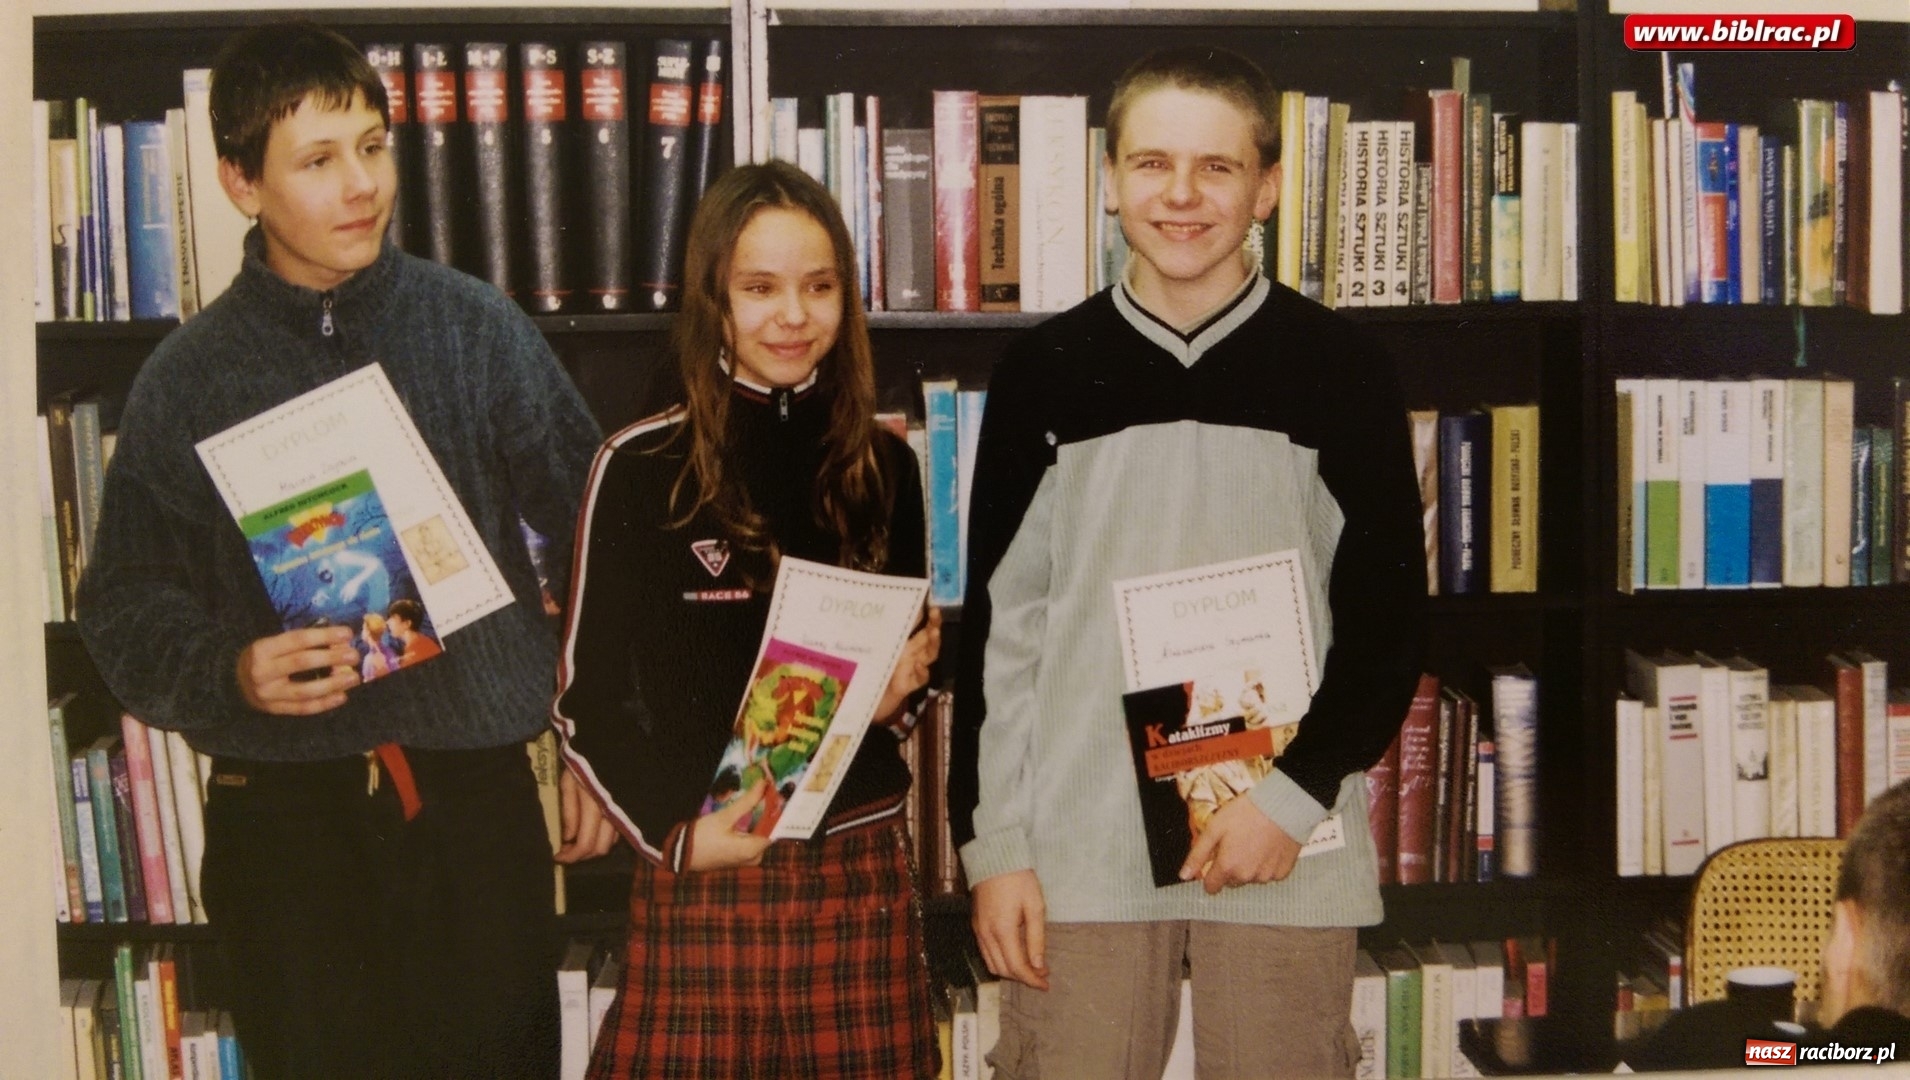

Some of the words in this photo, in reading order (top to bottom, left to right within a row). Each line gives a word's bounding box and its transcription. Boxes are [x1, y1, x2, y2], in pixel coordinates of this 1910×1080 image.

[661, 137, 675, 158] 7
[1355, 130, 1369, 208] HISTORIA
[1375, 129, 1389, 208] HISTORIA
[1397, 129, 1412, 208] HISTORIA
[991, 176, 1007, 214] ogólna
[991, 218, 1005, 270] Technika
[1353, 210, 1368, 272] SZTUKI
[1374, 210, 1387, 272] SZTUKI
[1395, 210, 1410, 272] SZTUKI
[1351, 282, 1366, 298] 2
[1372, 280, 1386, 297] 3
[1394, 280, 1408, 297] 4
[263, 412, 348, 460] DYPLOM
[263, 501, 296, 520] ALFRED
[700, 591, 732, 600] RACE
[820, 596, 885, 618] DYPLOM
[1172, 588, 1257, 618] DYPLOM
[1145, 723, 1230, 748] Kataklizmy
